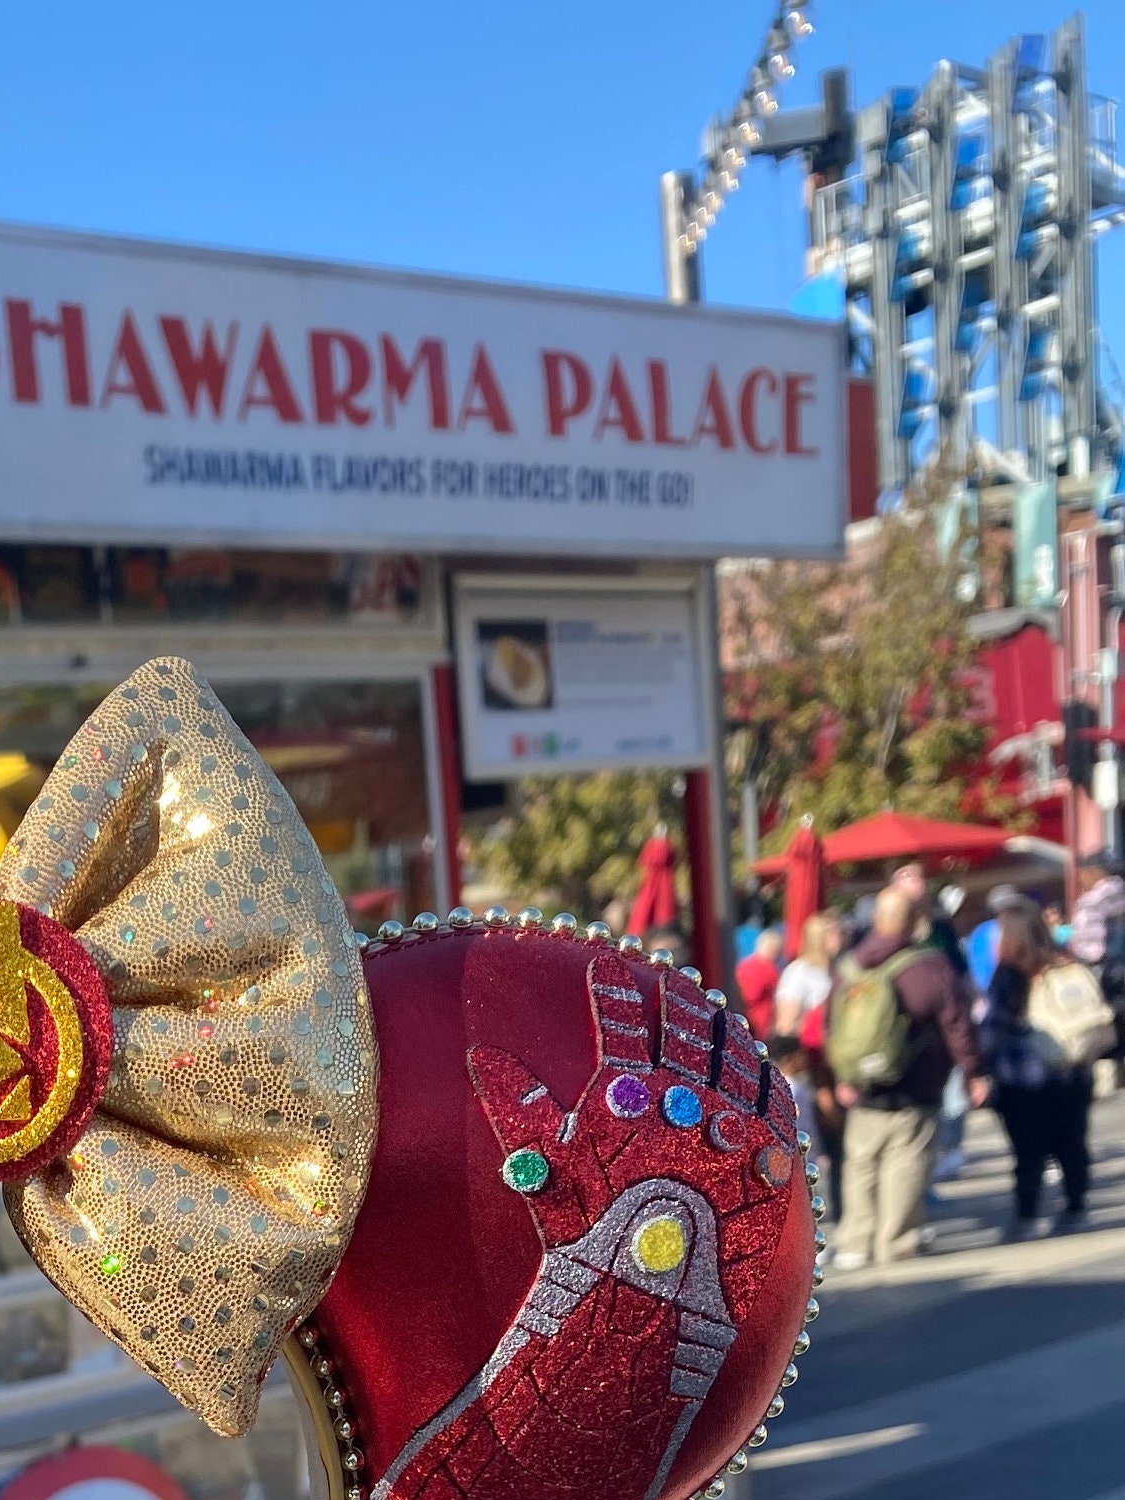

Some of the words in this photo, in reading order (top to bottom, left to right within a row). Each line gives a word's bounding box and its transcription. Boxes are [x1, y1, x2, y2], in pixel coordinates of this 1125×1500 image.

[542, 348, 820, 457] PALACE
[144, 444, 305, 490] SHAWARMA
[311, 454, 424, 497] FLAVORS
[431, 458, 476, 498] FOR
[484, 461, 572, 503] HEROES
[577, 465, 610, 503] ON
[614, 467, 652, 505] THE
[657, 470, 694, 507] GO!
